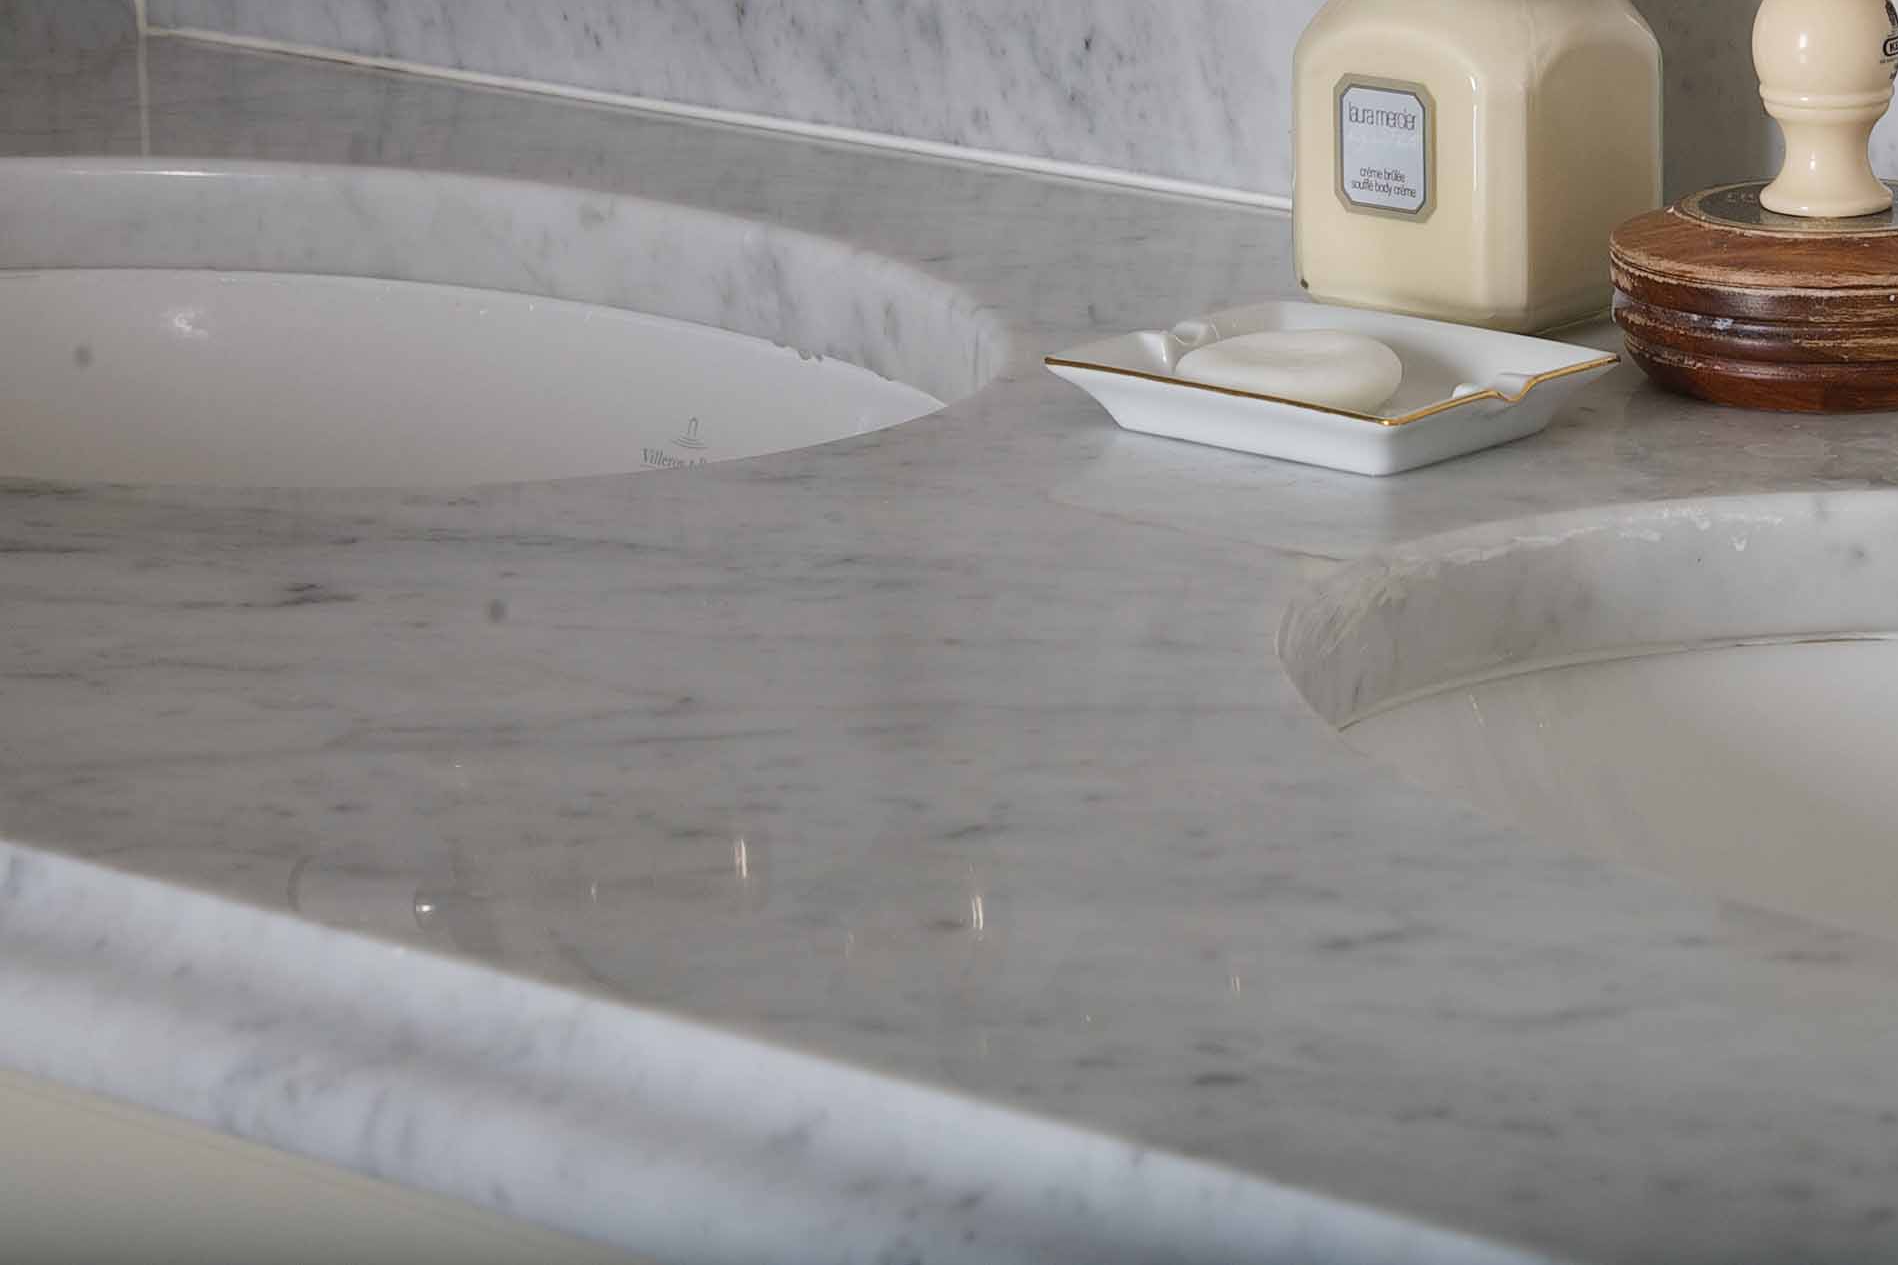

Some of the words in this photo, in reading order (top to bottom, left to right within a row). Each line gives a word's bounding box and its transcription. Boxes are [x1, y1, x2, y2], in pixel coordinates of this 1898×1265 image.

[1348, 101, 1374, 125] laura
[1375, 106, 1416, 131] mercier
[1374, 179, 1393, 197] body
